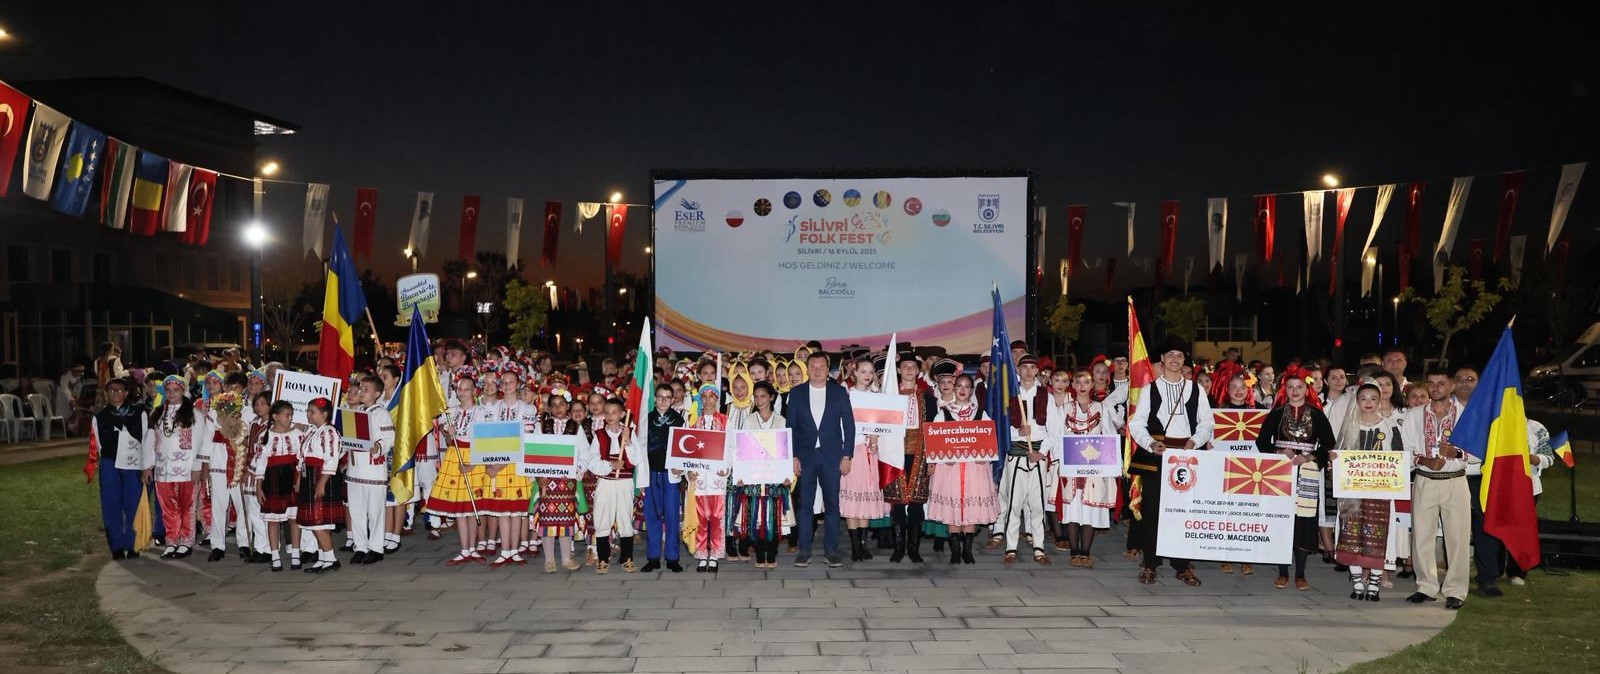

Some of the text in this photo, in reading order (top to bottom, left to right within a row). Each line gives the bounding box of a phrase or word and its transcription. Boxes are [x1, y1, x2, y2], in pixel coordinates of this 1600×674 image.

[675, 210, 705, 220] ESER
[800, 218, 848, 232] SİLİVRİ
[800, 233, 875, 244] FOLK FEST
[778, 262, 798, 270] HOŞ
[849, 262, 896, 270] WELCOME
[285, 381, 329, 396] ROMANIA
[928, 426, 992, 436] Świerczkowiacy
[341, 440, 364, 449] OMANYA
[945, 436, 977, 444] POLAND
[682, 462, 710, 470] TÜRKİYE
[1184, 520, 1269, 533] GOCE DELCHEV
[1227, 533, 1271, 543] MACEDONIA
